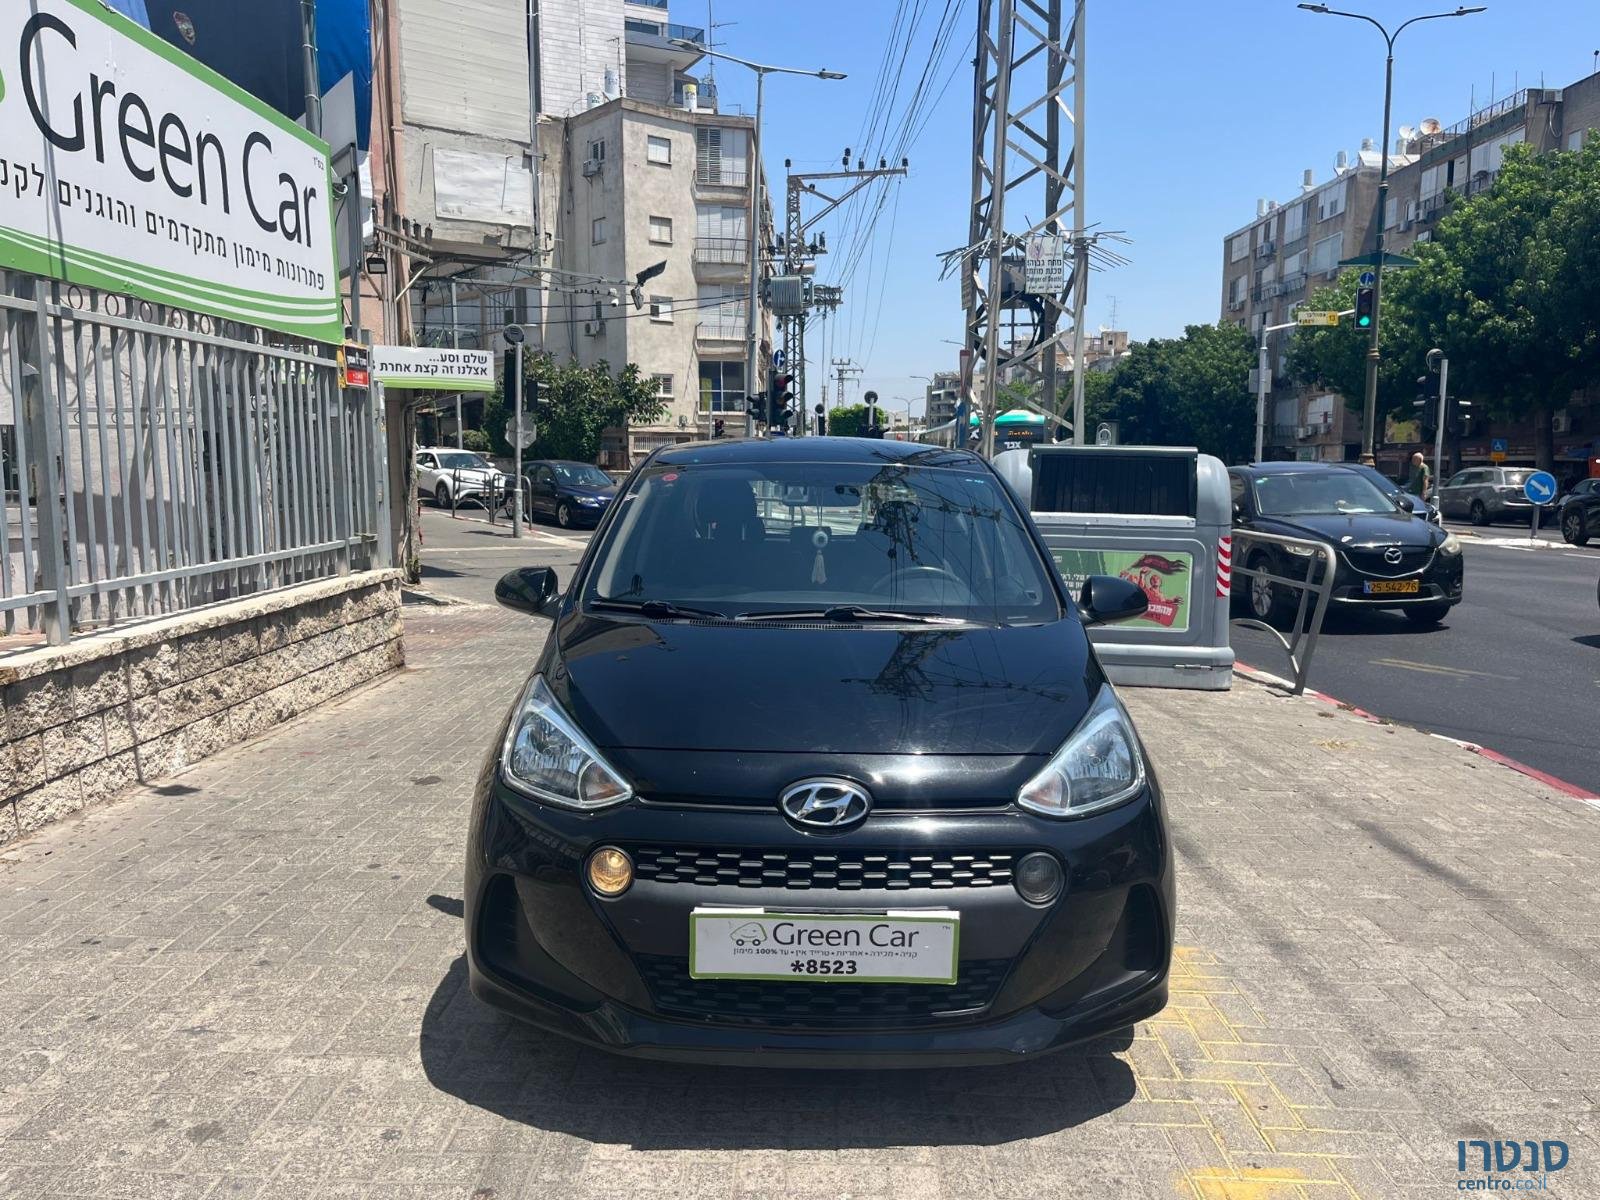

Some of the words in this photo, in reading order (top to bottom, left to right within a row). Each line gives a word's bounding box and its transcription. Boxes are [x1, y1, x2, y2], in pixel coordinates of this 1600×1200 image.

[19, 12, 230, 215] Green
[243, 131, 317, 248] Car
[58, 179, 136, 228] והוגנים
[145, 210, 227, 258] מתקדמים
[233, 242, 271, 273] מימון
[276, 258, 324, 290] פתרונות
[379, 362, 411, 373] אחרת
[415, 363, 438, 376] קצת
[442, 365, 454, 374] זה
[458, 364, 488, 376] אצלנו
[463, 353, 488, 364] שלם
[773, 922, 860, 946] Green
[869, 923, 919, 948] Car
